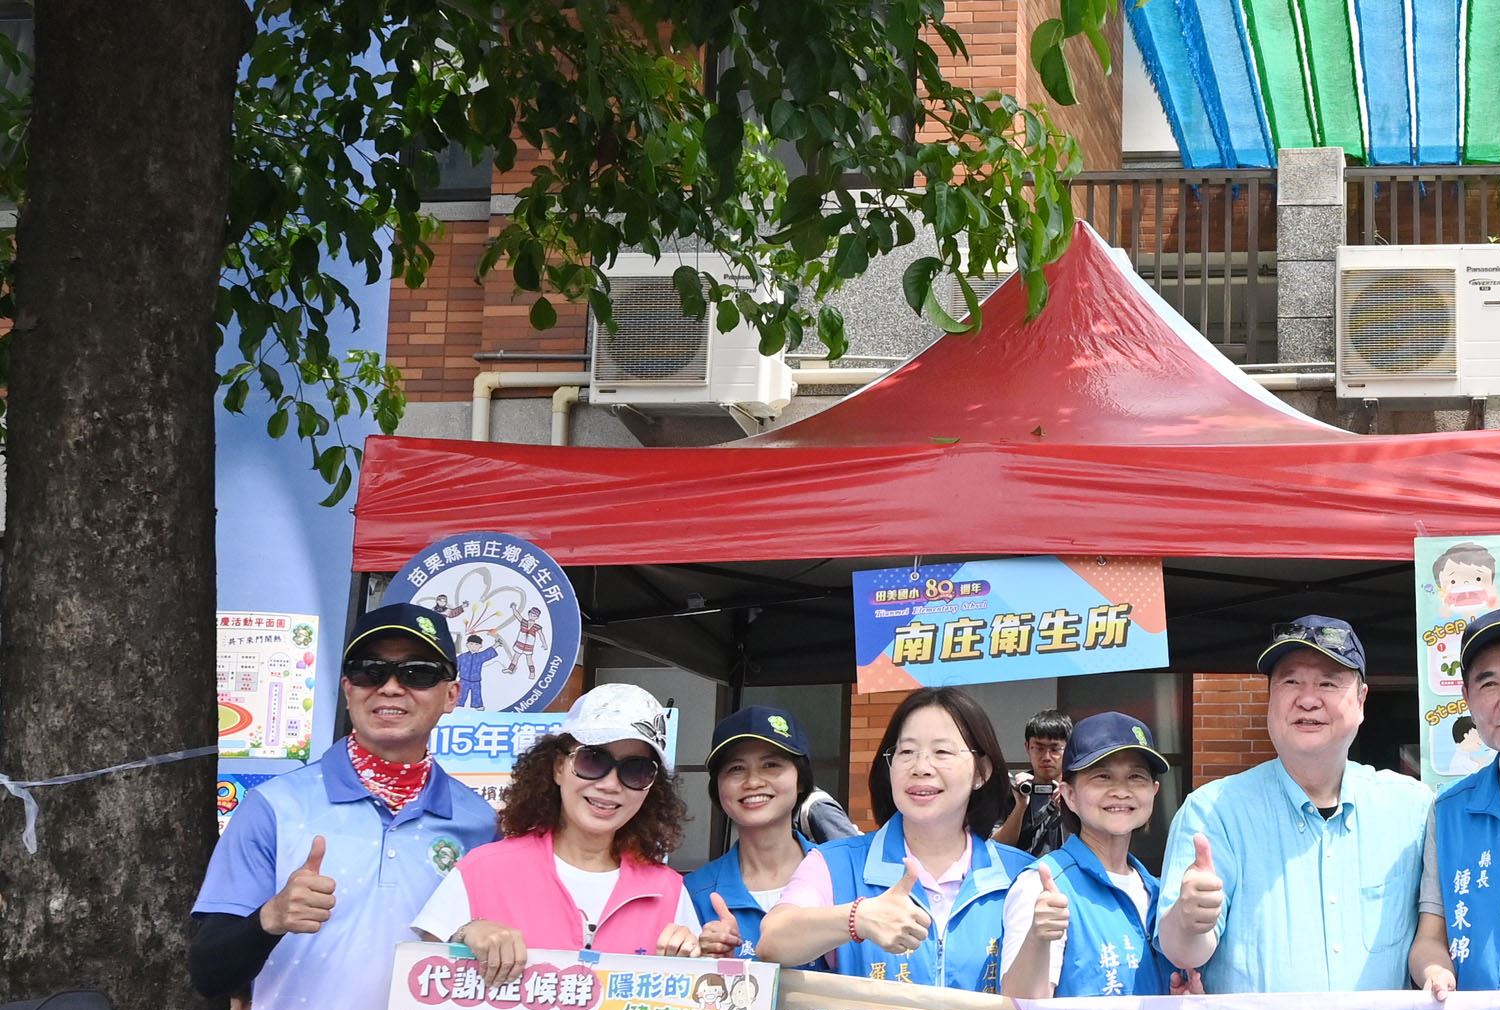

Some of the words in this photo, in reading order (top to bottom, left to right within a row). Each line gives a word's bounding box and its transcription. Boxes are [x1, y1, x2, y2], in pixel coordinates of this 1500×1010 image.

[407, 540, 564, 604] 苗栗縣南庄鄉衛生所
[875, 588, 920, 602] 田美國小
[960, 582, 982, 595] 週年
[216, 616, 286, 629] 慶活動平面圖
[892, 602, 1135, 666] 南庄衛生所
[514, 688, 544, 713] Miaoli
[538, 655, 563, 689] County
[430, 723, 563, 757] 115年衛
[1476, 850, 1492, 888] 縣長
[1449, 868, 1472, 963] 鍾東錦
[1123, 935, 1140, 969] 主任
[607, 972, 691, 999] 隱形的
